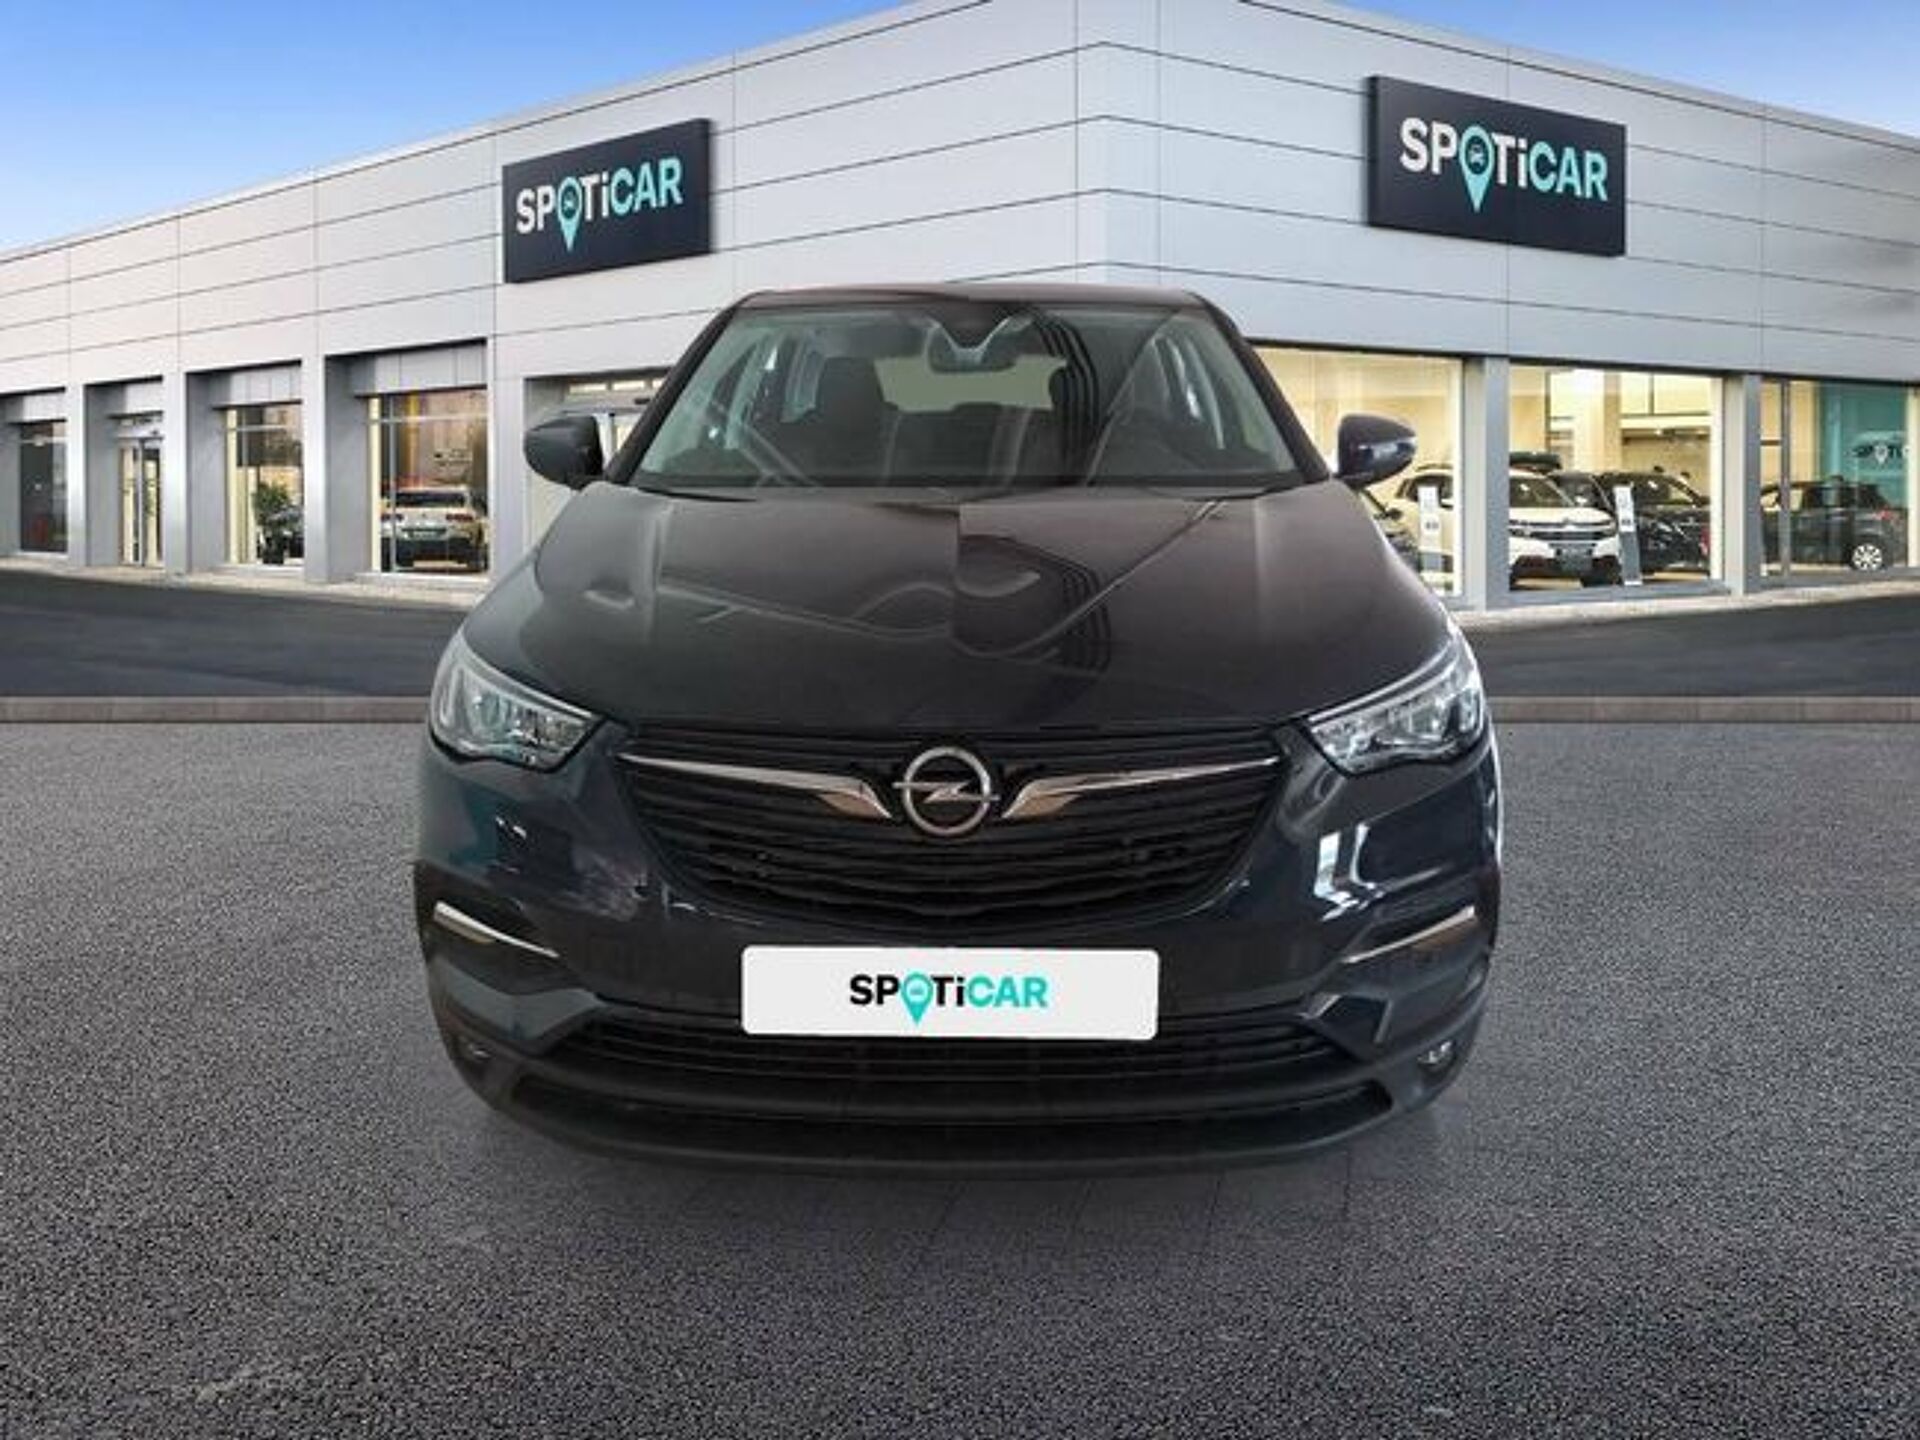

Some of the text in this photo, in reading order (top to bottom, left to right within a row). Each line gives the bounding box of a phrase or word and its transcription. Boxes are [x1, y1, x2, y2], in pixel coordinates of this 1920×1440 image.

[516, 155, 684, 252] SPOTiCAR
[1399, 116, 1609, 213] SPOTiCAR
[849, 971, 1049, 1025] SPOTiCAR
